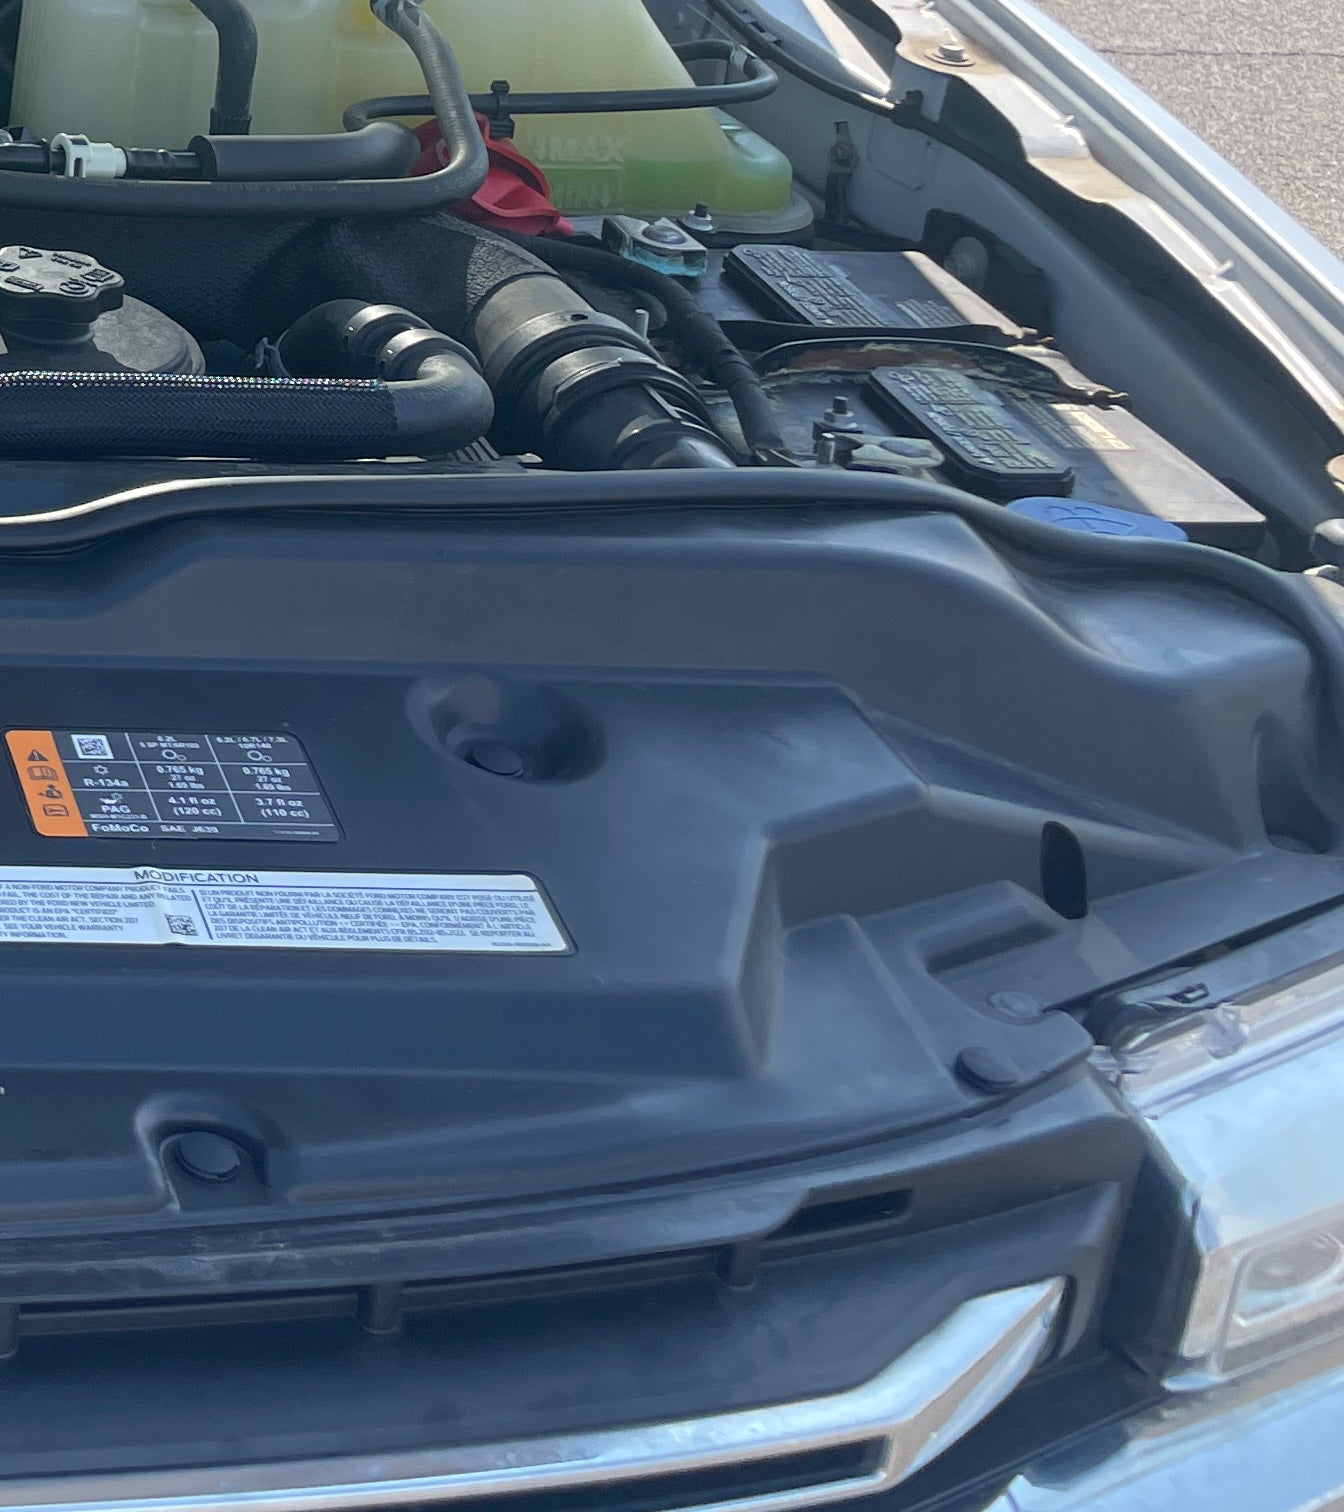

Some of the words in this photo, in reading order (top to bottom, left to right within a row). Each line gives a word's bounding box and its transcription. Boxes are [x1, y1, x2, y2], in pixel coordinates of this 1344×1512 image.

[188, 766, 204, 776] kg
[274, 767, 291, 778] kg
[83, 778, 130, 787] R-134a
[168, 796, 186, 804] 4.1
[255, 797, 273, 806] 3.7
[101, 805, 131, 814] PAG
[202, 807, 222, 817] cc)
[289, 809, 310, 819] cc)
[91, 823, 150, 833] FoMoCo
[160, 824, 187, 833] SAE
[133, 870, 260, 884] MODIFICATION
